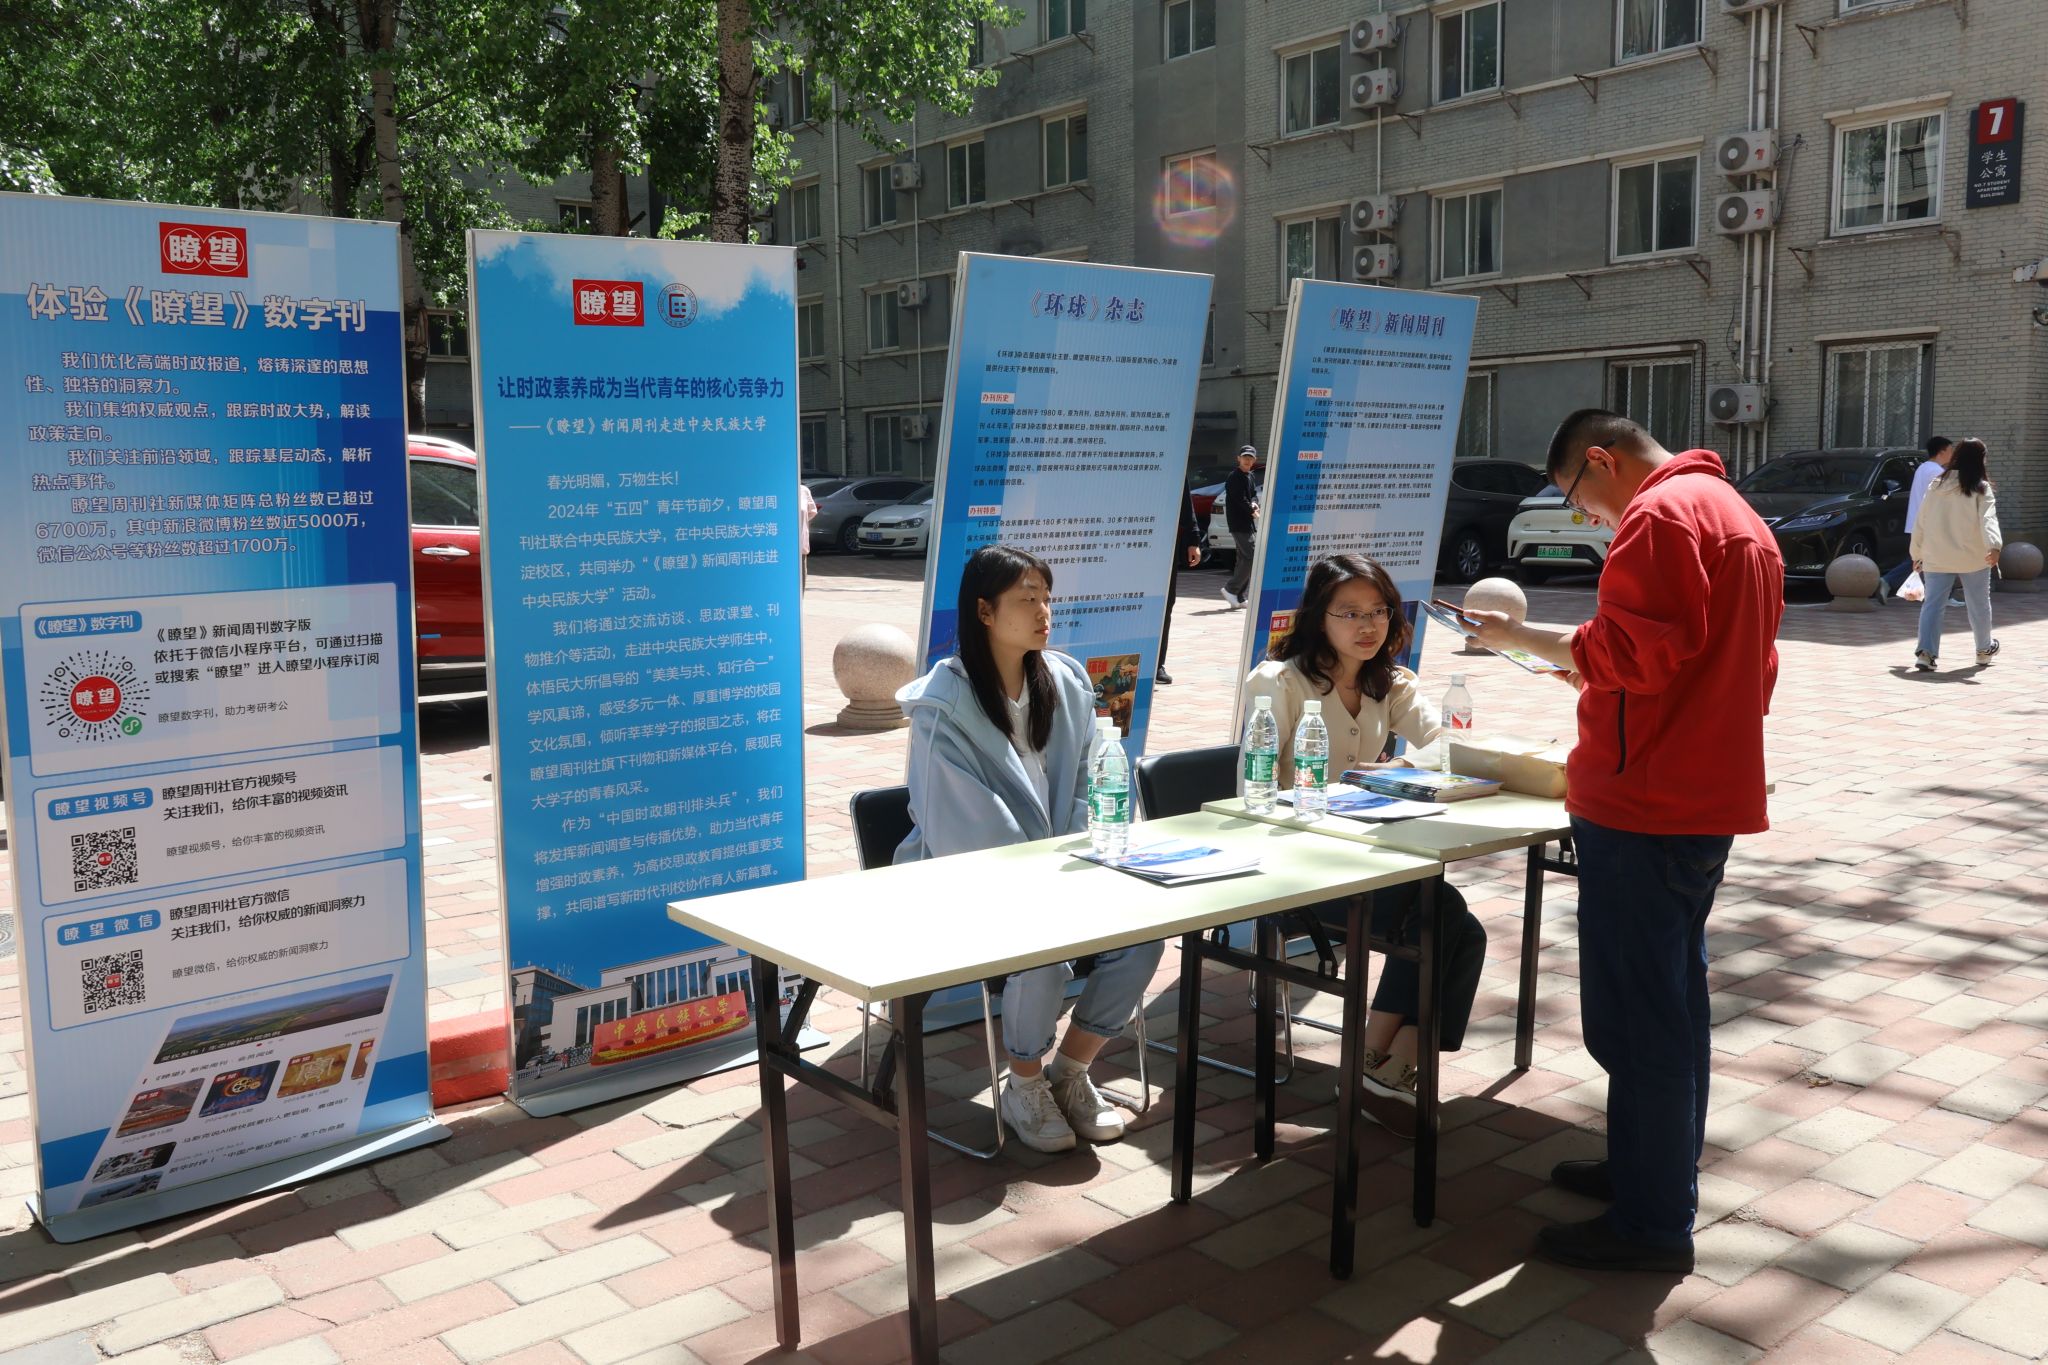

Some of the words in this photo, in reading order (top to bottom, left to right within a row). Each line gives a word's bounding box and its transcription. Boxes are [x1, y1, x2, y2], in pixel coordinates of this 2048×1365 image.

[1989, 106, 2004, 135] 7
[1981, 150, 2008, 164] 学生
[1980, 165, 2007, 179] 公寓
[1987, 179, 2010, 187] STUDENT
[1977, 185, 2007, 193] APARTMENT
[169, 234, 239, 267] 瞭望
[26, 283, 366, 332] 体验《瞭望》数字刊
[580, 290, 637, 317] 瞭望
[1031, 288, 1145, 322] 《环球》杂志
[1331, 307, 1446, 337] 《瞭望》新闻周刊
[62, 351, 369, 374] 我们优化高端时政报道，熔铸深邃的思想
[25, 375, 181, 395] 性、独特的洞察力。
[498, 376, 784, 400] 让时政素养成为当代青年的核心竞争力
[982, 393, 1009, 403] 办刊历史
[65, 401, 371, 420] 我们集纳权威观点，跟踪时政大势，解读
[29, 426, 113, 443] 政策走向。
[67, 447, 372, 467] 我们关注前沿领域，跟踪基层动态，解析
[32, 473, 115, 491] 热点事件。
[547, 471, 679, 490] 春光明媚，万物生长！
[71, 491, 374, 515] 瞭望周刊社新媒体矩阵总粉丝数已超过
[548, 495, 777, 519] 2024年“五四”青年节前夕，瞭望周
[35, 513, 367, 540] 6700万，其中新浪微博粉丝数近5000万，
[519, 522, 778, 551] 刊社联合中央民族大学，在中央民族大学海
[37, 538, 297, 564] 微信公众号等粉丝数超过1700万。
[520, 549, 779, 580] 淀校区，共同举办“《瞭望》新闻周刊走进
[522, 586, 657, 610] 中央民族大学”活动。
[36, 614, 133, 636] 《瞭望》数字刊
[156, 618, 311, 643] 《瞭望》新闻周刊数字版
[552, 602, 780, 636] 我们将通过交流访谈、思政课堂、刊
[154, 633, 383, 663] 依托于微信小程序平台，可通过扫描
[524, 631, 773, 668] 物推介等活动，走进中央民族大学师生中，
[155, 652, 380, 684] 或搜索“瞭望”进入瞭望小程序订阅
[526, 655, 774, 697] 体悟民大所倡导的“美美与共、知行合一”
[75, 686, 116, 707] 瞭望
[527, 682, 781, 725] 学风真谛，感受多元一体、厚重博学的校园
[158, 701, 288, 723] 瞭望数字刊，助力考研考公
[528, 708, 781, 754] 文化氛围，倾听莘莘学子的报国之志，将在
[530, 733, 782, 782] 瞭望周刊社旗下刊物和新媒体平台，展现民
[162, 772, 297, 800] 瞭望周刊社官方视频号
[531, 780, 650, 810] 大学子的青春风采。
[54, 792, 147, 816] 瞭望视频号
[163, 784, 349, 821] 关注我们，给你丰富的视频资讯
[562, 785, 783, 833] 作为“中国时政期刊排头兵”，我们
[166, 824, 325, 857] 瞭望视频号，给你丰富的视频资讯
[534, 811, 783, 866] 将发挥新闻调查与传播优势，助力当代青年
[535, 837, 784, 893] 增强时政素养，为高校思政教育提供重要支
[169, 888, 290, 921] 瞭望周刊社官方微信
[536, 863, 779, 921] 撑，共同谱写新时代刊校协作育人新篇章。
[64, 914, 153, 941] 瞭望微信
[170, 895, 365, 941] 关注我们，给你权威的新闻洞察力
[172, 940, 329, 979] 瞭望微信，给你权威的新闻洞察力
